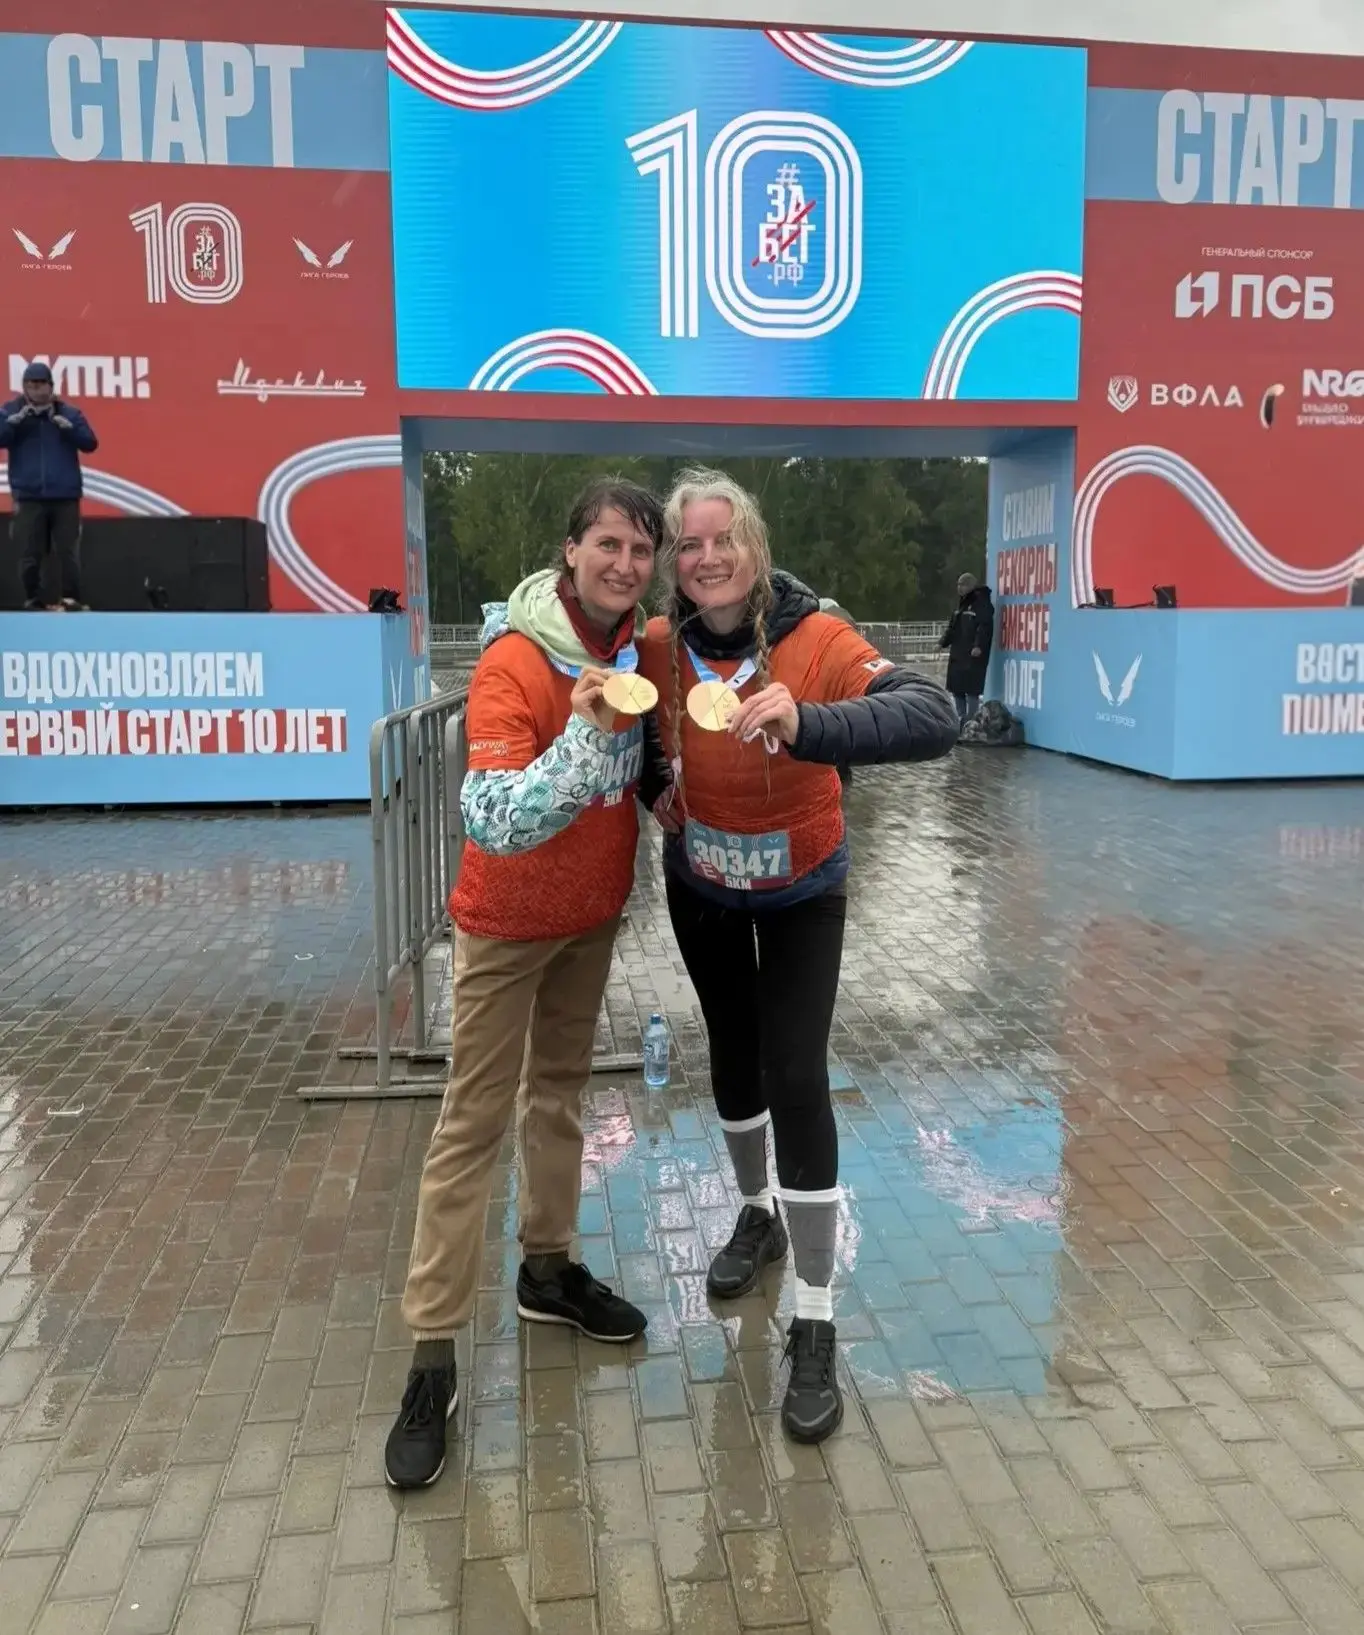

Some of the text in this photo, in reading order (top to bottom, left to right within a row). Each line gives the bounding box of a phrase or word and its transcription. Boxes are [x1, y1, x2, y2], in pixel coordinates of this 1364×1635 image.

[47, 33, 305, 168] СТАРТ
[1157, 88, 1364, 209] СТАРТ
[625, 108, 863, 339] 10
[766, 184, 809, 224] ЗА
[129, 202, 244, 304] 10
[758, 223, 817, 264] БЕГ
[1231, 274, 1335, 320] ПСБ
[1151, 383, 1244, 408] ВФЛА
[3, 651, 264, 704] ВДОХНОВЛЯЕМ
[1018, 660, 1045, 710] ЛЕТ
[126, 708, 233, 755] СТАРТ
[238, 708, 277, 754] 10
[284, 708, 347, 754] ЛЕТ
[693, 839, 780, 877] 30347
